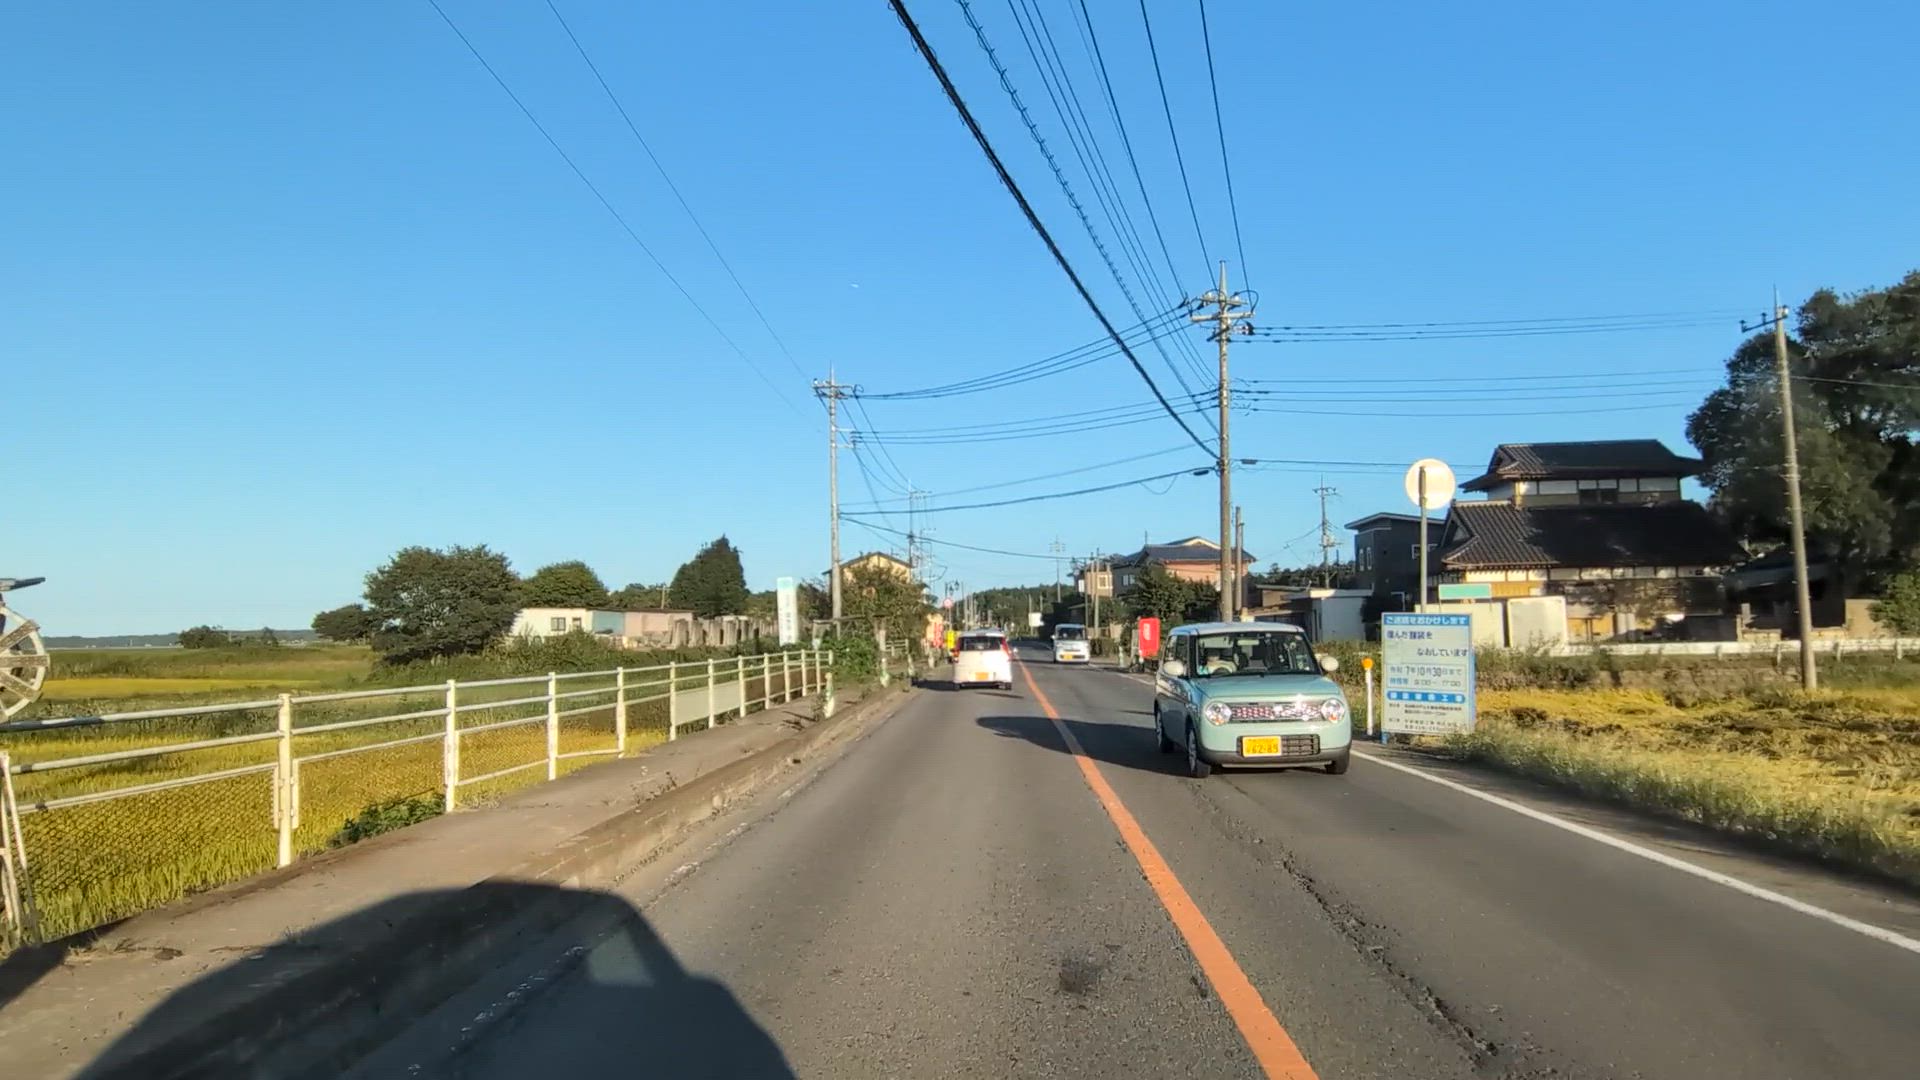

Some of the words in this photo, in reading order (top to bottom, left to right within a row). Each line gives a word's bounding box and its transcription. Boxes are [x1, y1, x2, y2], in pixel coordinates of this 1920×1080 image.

[1386, 616, 1466, 625] ご迷惑をおかけします
[1417, 648, 1467, 657] なおしています
